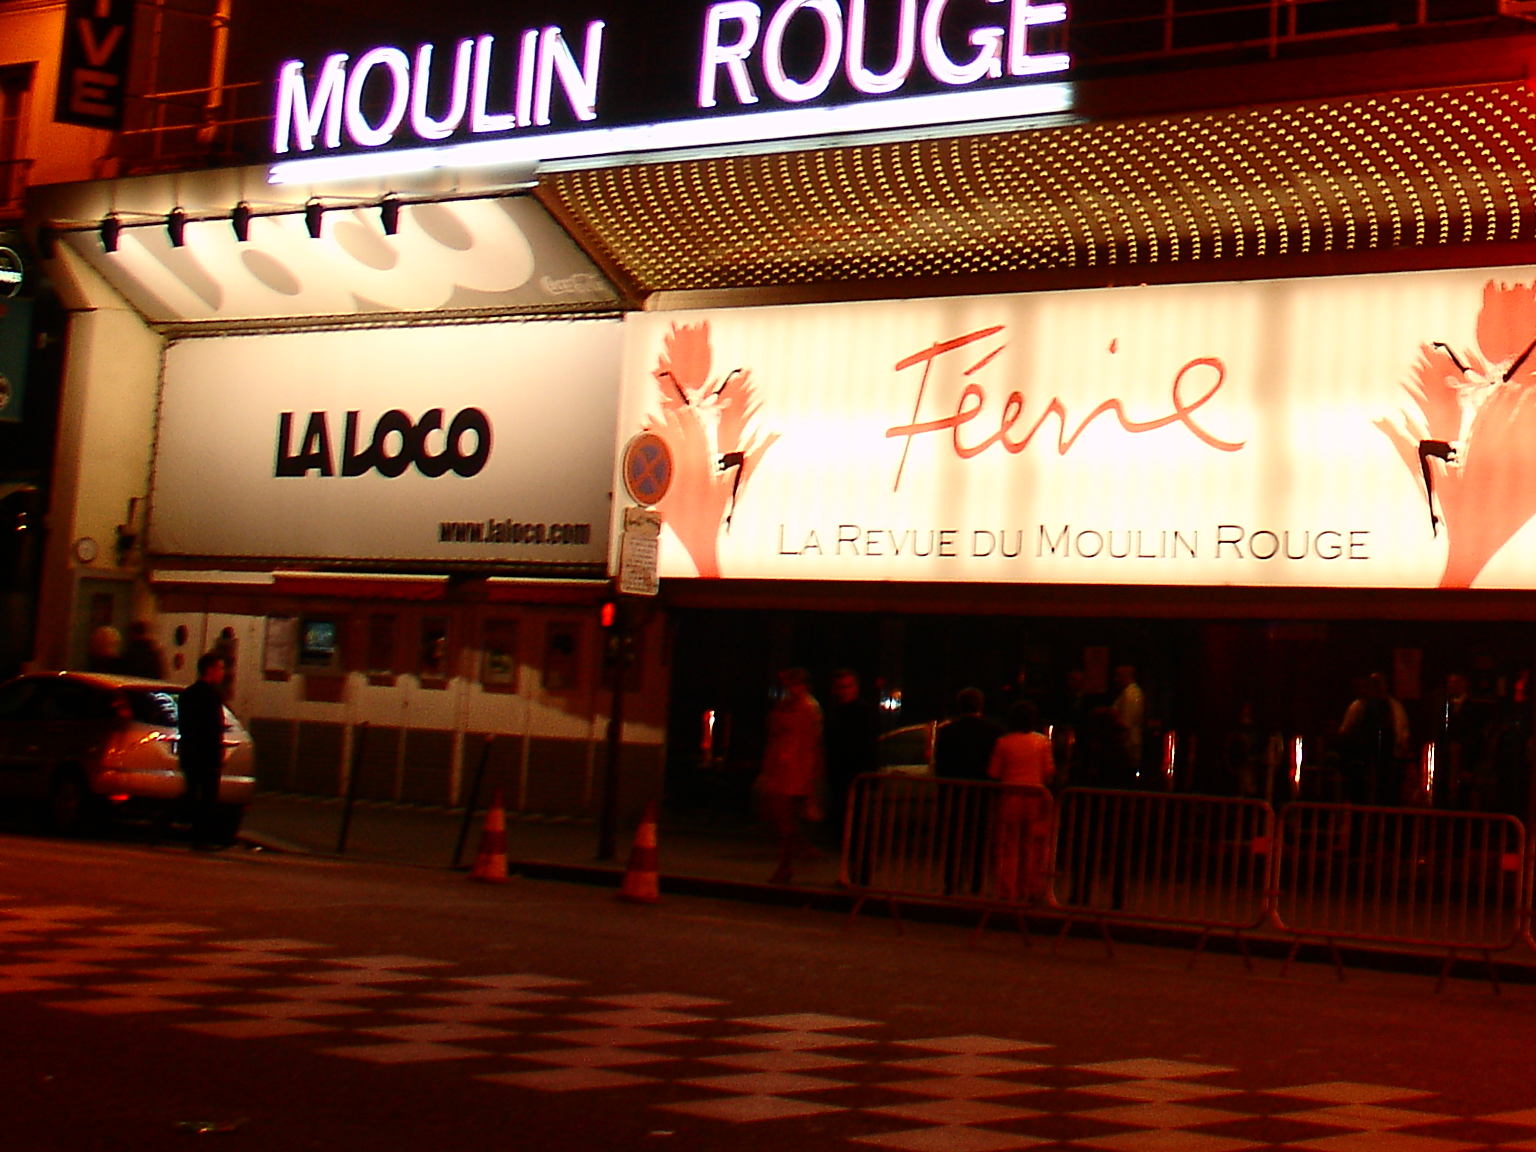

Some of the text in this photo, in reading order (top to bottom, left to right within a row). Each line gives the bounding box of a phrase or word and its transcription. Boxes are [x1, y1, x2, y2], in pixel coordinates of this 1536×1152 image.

[273, 20, 605, 155] MOULIN
[274, 406, 494, 479] LA LOCO
[885, 323, 1249, 493] Féerie
[438, 517, 592, 545] www.laloco.com
[778, 523, 1371, 561] LA REVUE DU MOULIN ROUGE
